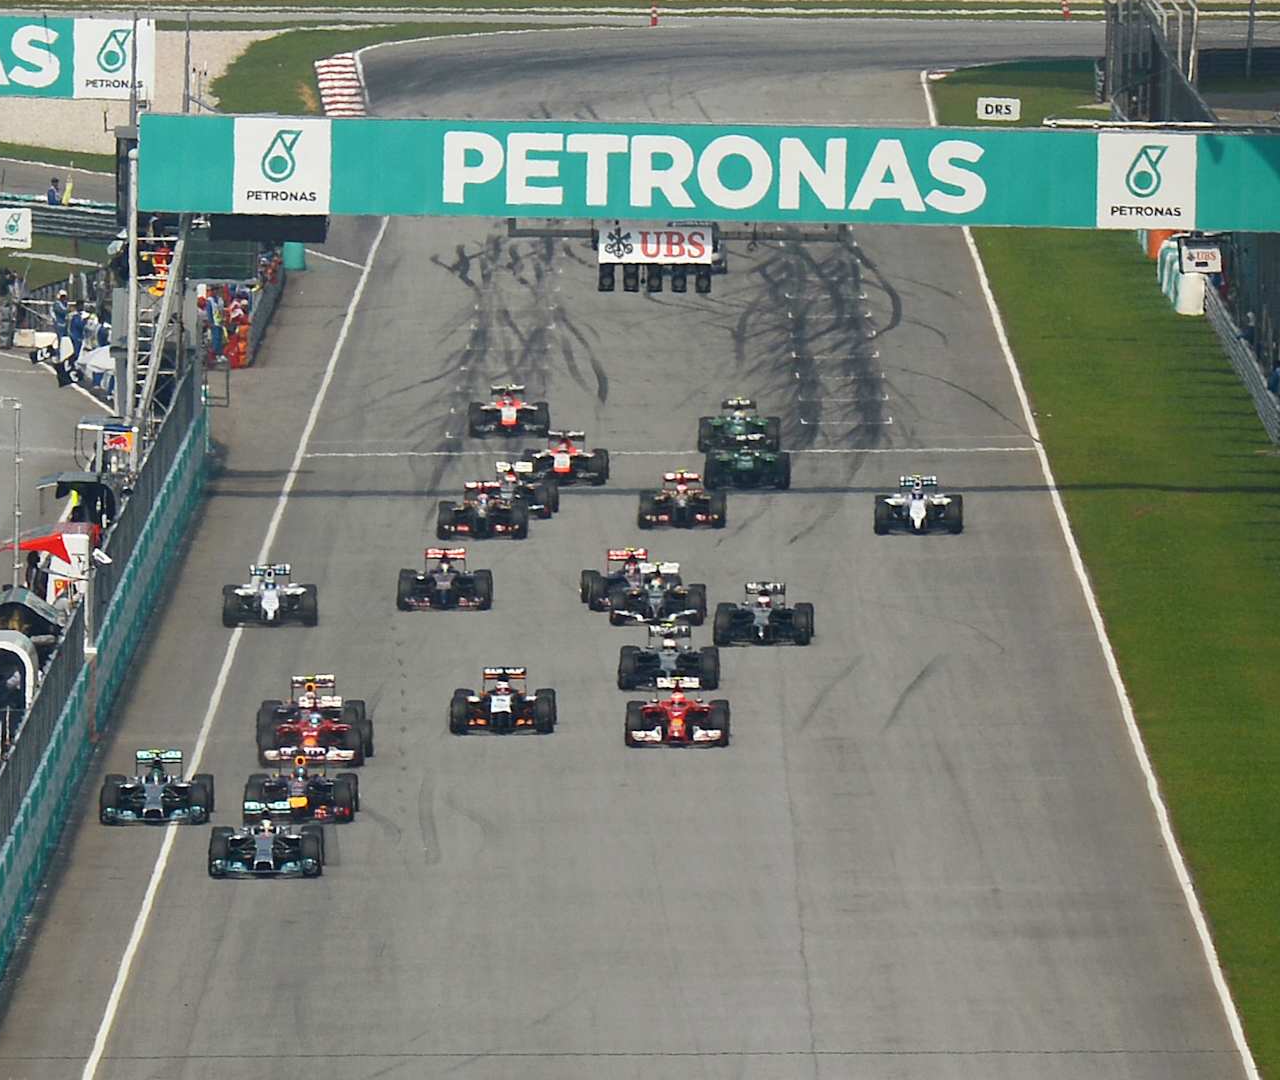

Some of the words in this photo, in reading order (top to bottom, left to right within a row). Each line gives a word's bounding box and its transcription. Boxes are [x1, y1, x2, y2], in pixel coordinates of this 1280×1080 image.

[985, 103, 1012, 116] DRS
[442, 130, 988, 214] PETRONAS
[246, 190, 317, 202] PETRONAS
[1110, 205, 1182, 217] PETRONAS
[640, 230, 706, 260] UBS
[1196, 251, 1217, 261] UBS
